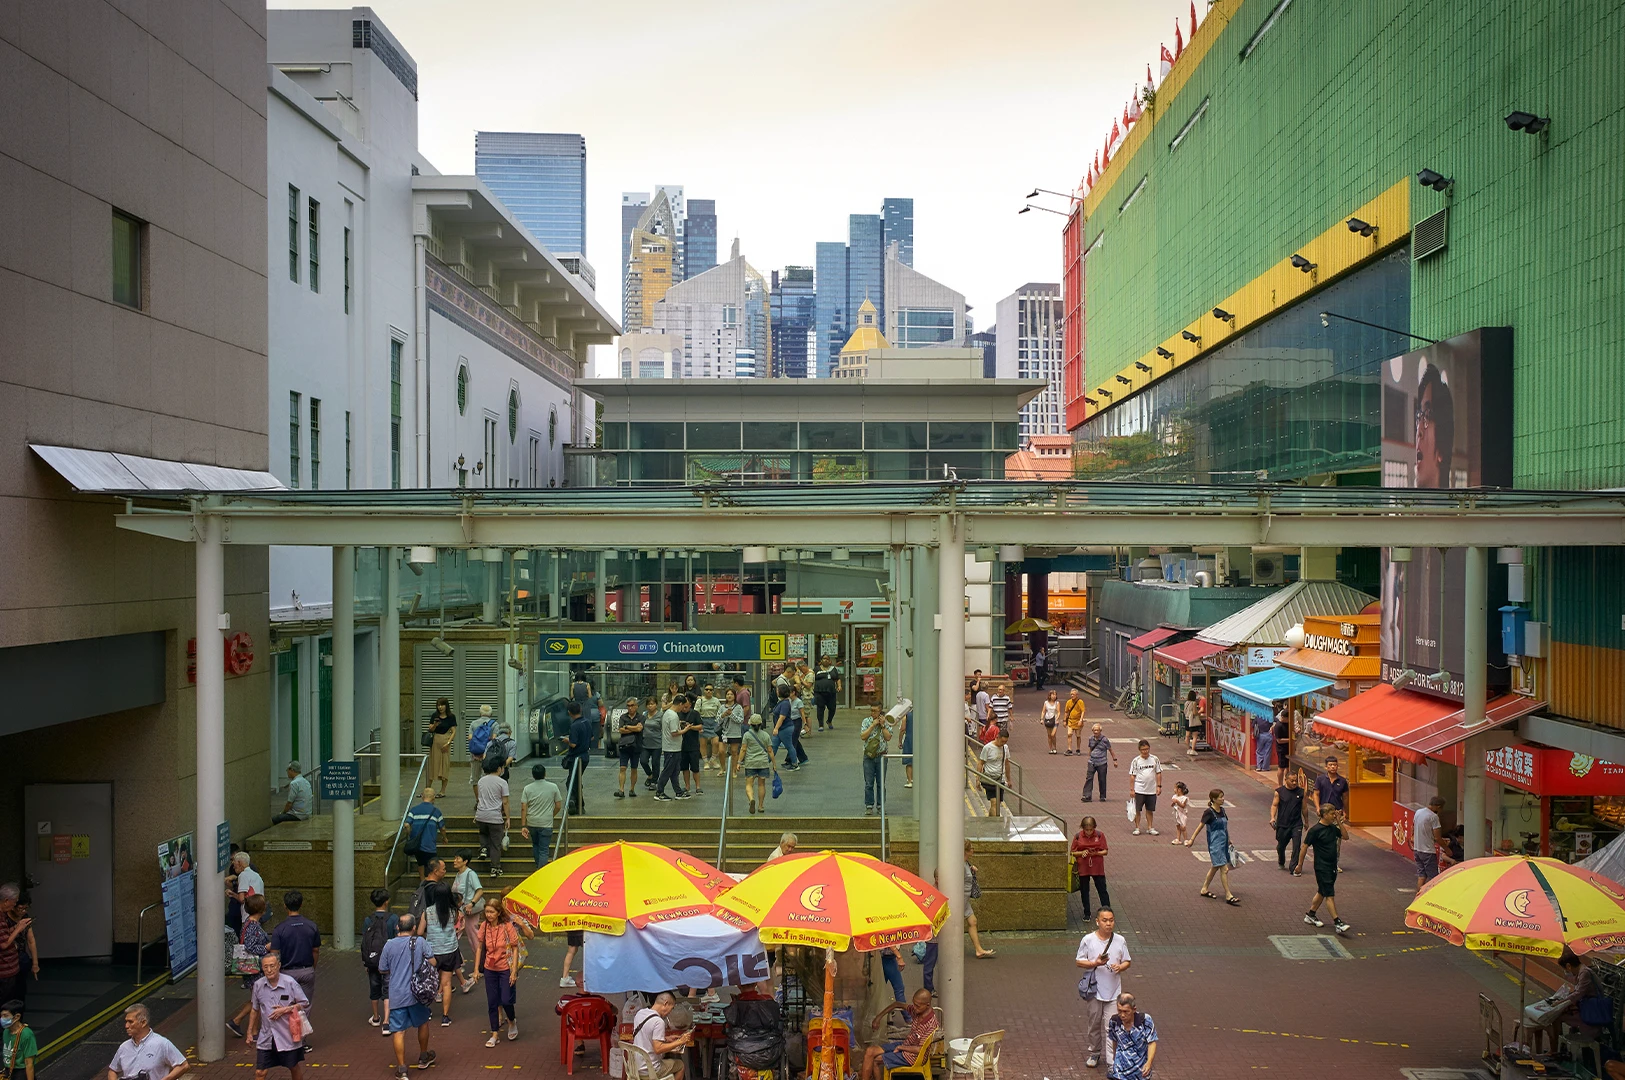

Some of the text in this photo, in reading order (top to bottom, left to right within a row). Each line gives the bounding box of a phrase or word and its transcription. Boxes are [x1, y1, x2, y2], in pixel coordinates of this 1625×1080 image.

[840, 601, 853, 619] 7
[663, 642, 724, 653] Chinatown
[769, 642, 777, 653] C
[1416, 636, 1424, 646] Here
[568, 898, 609, 908] NewMoon
[656, 908, 700, 920] NewMoon
[788, 912, 831, 924] NewMoon
[552, 917, 568, 928] No.1
[577, 918, 612, 931] Singapore
[1425, 918, 1452, 937] NewMoon
[1495, 917, 1542, 931] NewMoon
[772, 931, 789, 940] No.1
[799, 934, 837, 946] Singapore
[879, 930, 920, 944] NewMoon
[1479, 938, 1497, 947] No.1
[1507, 942, 1549, 954] Singapore
